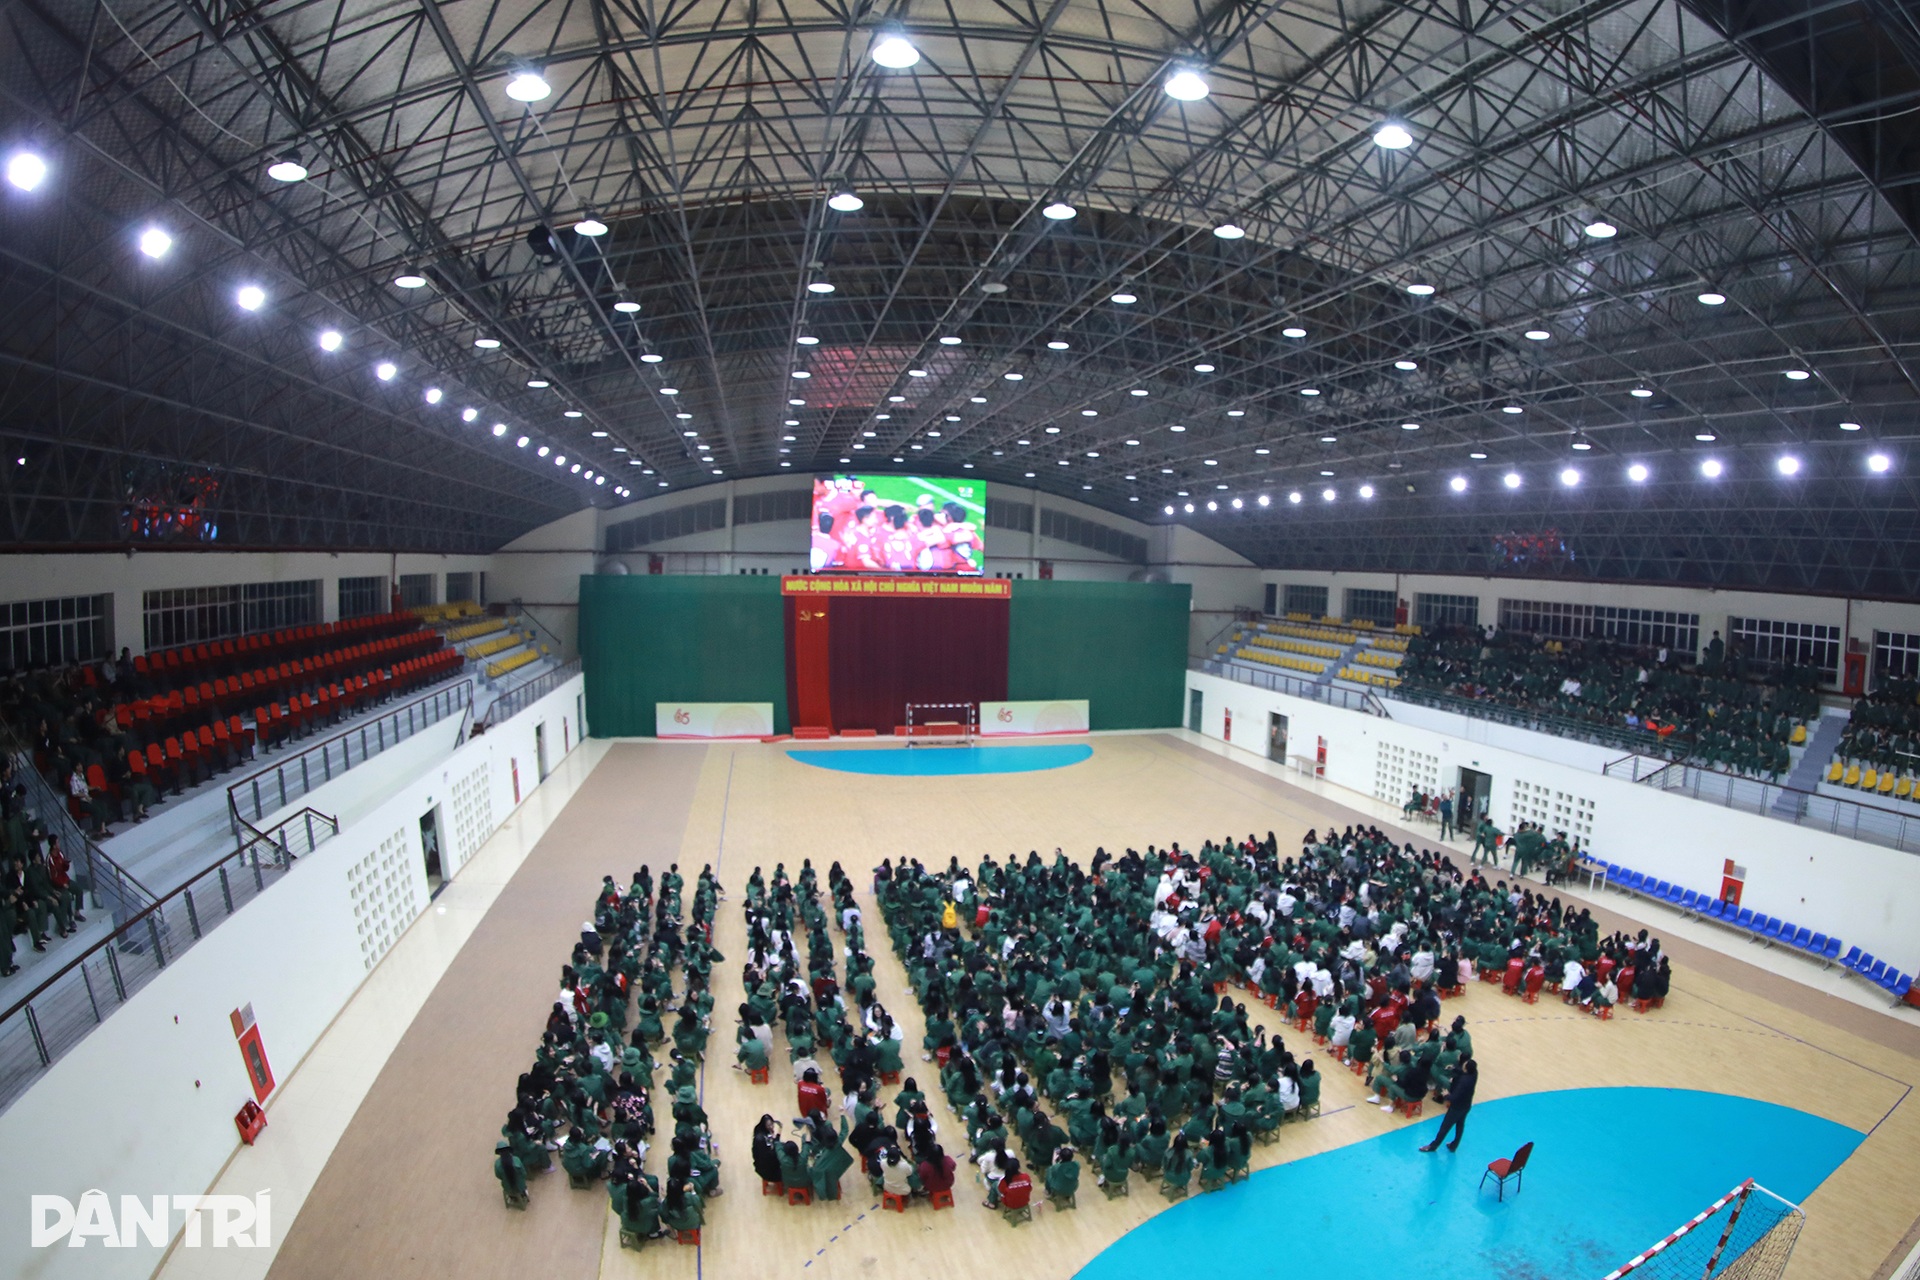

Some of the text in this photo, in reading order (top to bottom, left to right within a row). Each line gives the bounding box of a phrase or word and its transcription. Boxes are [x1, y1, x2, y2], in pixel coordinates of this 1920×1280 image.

[786, 579, 808, 591] NƯỚC
[810, 579, 832, 594] CỘNG
[863, 579, 877, 594] HỘI
[879, 578, 895, 592] CHỦ
[896, 580, 920, 592] NGHĨA
[922, 581, 938, 594] VIỆT
[940, 583, 958, 593] NAM
[960, 581, 983, 594] MUÔN
